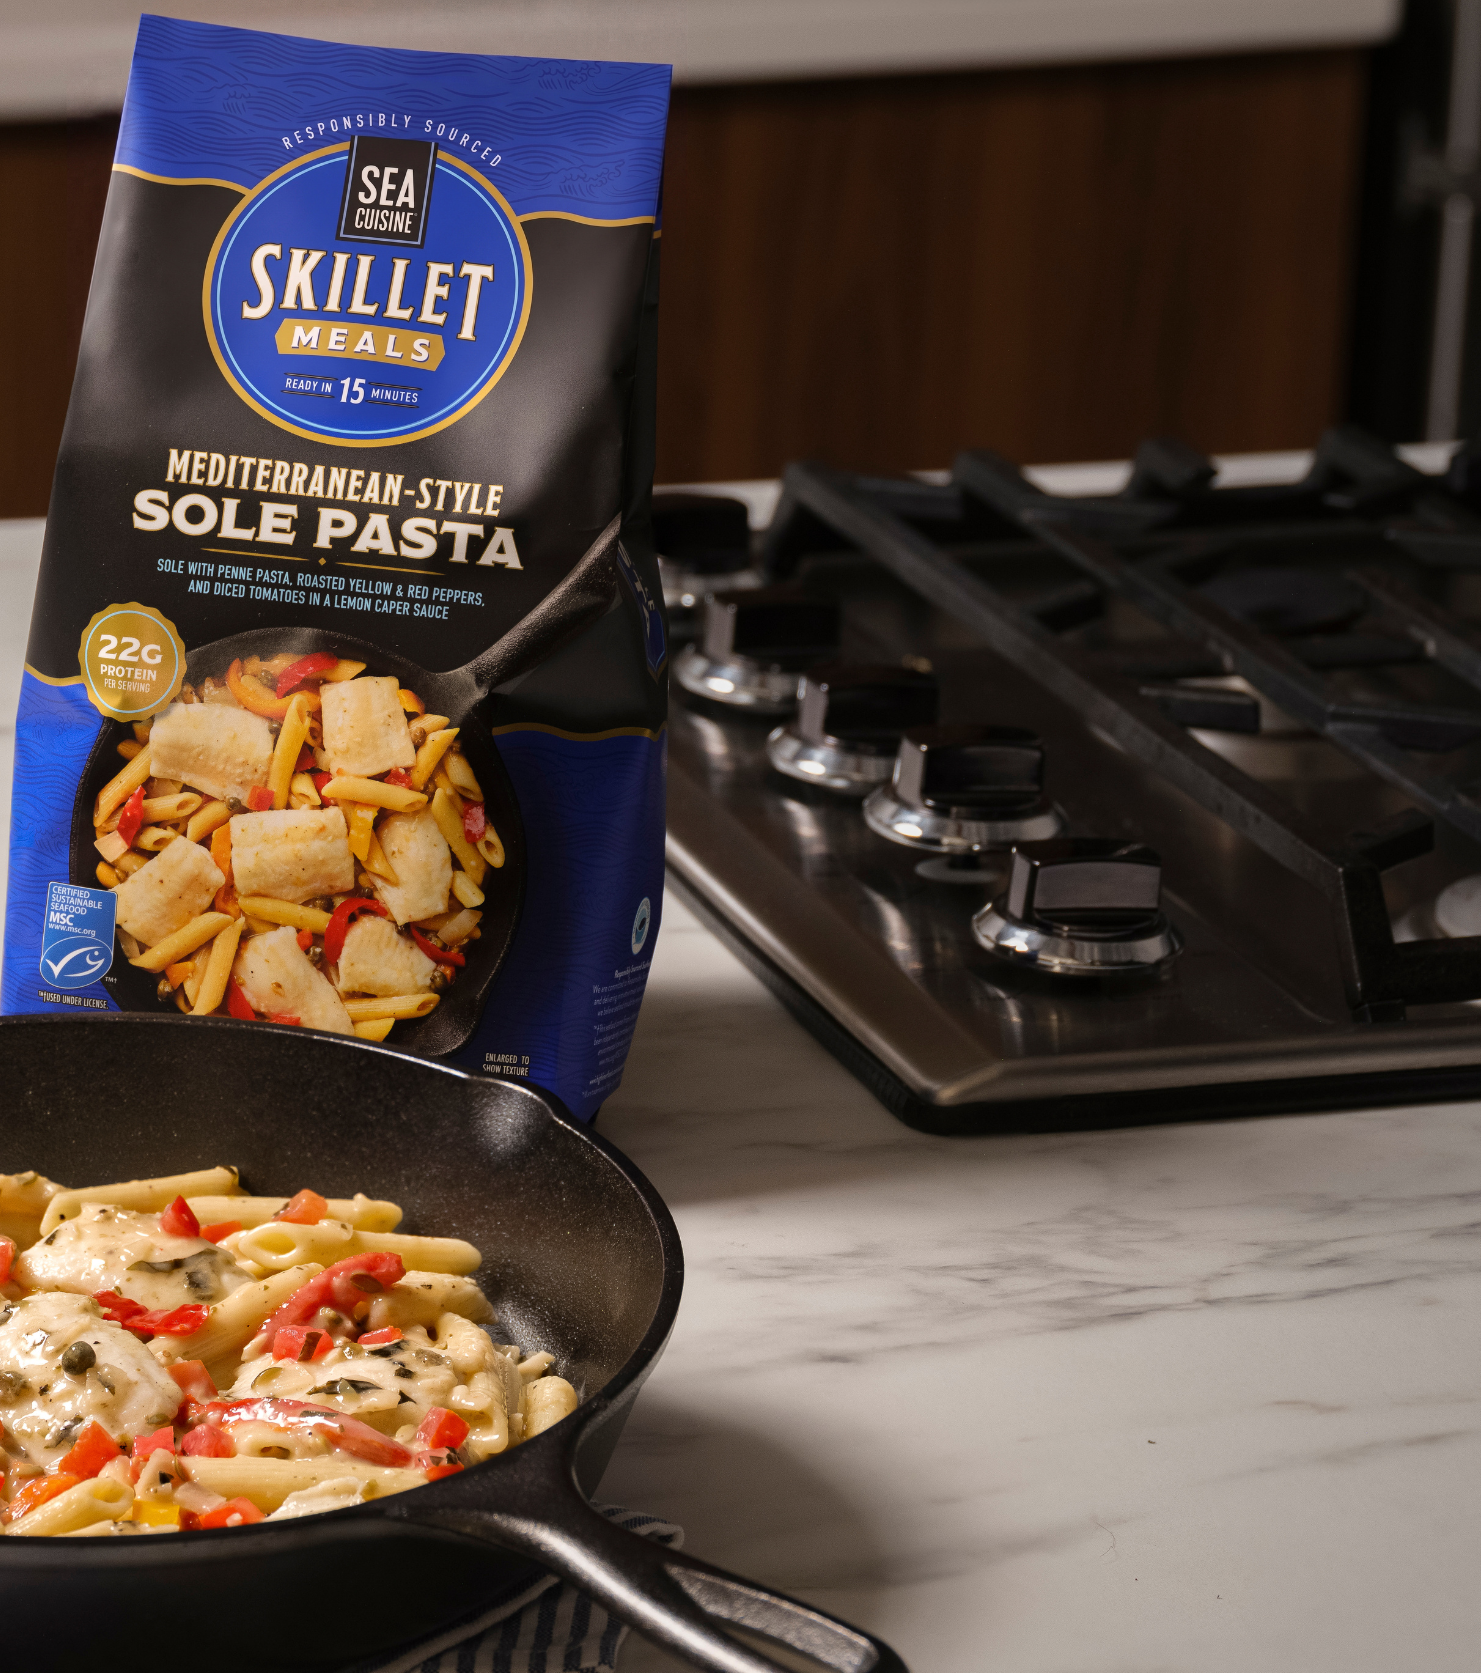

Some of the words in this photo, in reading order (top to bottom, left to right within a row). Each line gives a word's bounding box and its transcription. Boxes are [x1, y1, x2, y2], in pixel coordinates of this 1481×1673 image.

[282, 113, 412, 150] RESPONSIBLY
[424, 119, 502, 168] SOURCED
[358, 164, 415, 209] SEA
[354, 207, 414, 234] CUISINE
[241, 242, 494, 341] SKILLET
[290, 325, 430, 362] MEALS
[285, 377, 318, 391] READY
[321, 382, 333, 394] IN
[339, 376, 366, 405] 15
[370, 387, 419, 403] MINUTES
[166, 449, 504, 516] MEDITERRANEAN-STYLE
[133, 489, 298, 544] SOLE
[314, 508, 523, 569] PASTA
[156, 558, 185, 574] SOLE
[188, 561, 215, 577] WITH
[217, 564, 254, 581] PENNE
[255, 568, 293, 587] PASTA,
[296, 572, 346, 591] ROASTED
[349, 578, 393, 596] YELLOW
[395, 584, 404, 597] &
[407, 584, 429, 600] RED
[432, 587, 485, 607] PEPPERS,
[187, 579, 211, 594] AND
[213, 581, 246, 598] DICED
[249, 585, 306, 604] TOMATOES
[308, 591, 321, 606] IN
[323, 593, 331, 607] A
[334, 594, 372, 612] LEMON
[374, 598, 410, 616] CAPER
[413, 602, 450, 620] SAUCE
[97, 634, 163, 665] 22G
[100, 663, 157, 682] PROTEIN
[104, 677, 117, 689] PER
[117, 679, 151, 693] SERVING
[51, 893, 103, 910] SUSTAINABLE
[52, 885, 91, 899] CERTIFIED
[48, 910, 75, 926] MSC
[50, 901, 88, 915] SEAFOOD
[48, 922, 97, 938] www.msc.org
[62, 994, 82, 1006] UNDER
[482, 1063, 501, 1073] SHOW
[503, 1065, 528, 1076] TEXTURE
[485, 1053, 518, 1064] ENLARGED
[521, 1055, 530, 1065] TO
